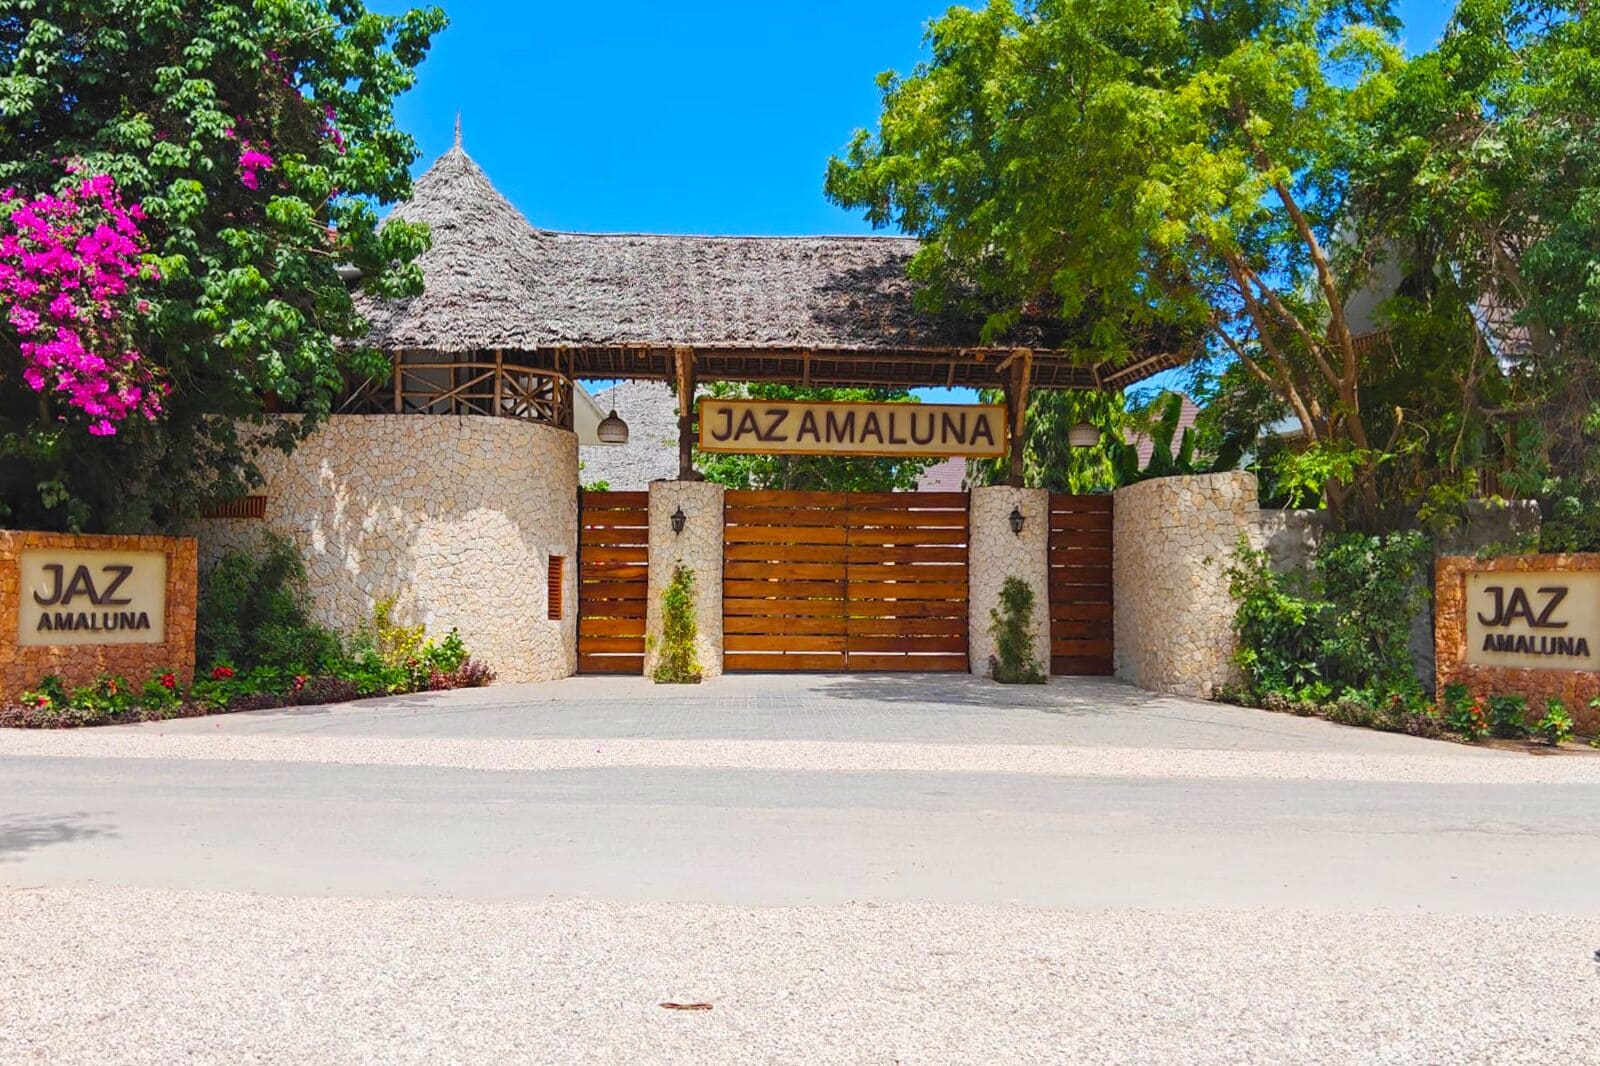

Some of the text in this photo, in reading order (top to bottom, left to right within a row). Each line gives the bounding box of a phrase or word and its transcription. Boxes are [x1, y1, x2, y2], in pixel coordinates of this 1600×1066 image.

[711, 408, 995, 446] JAZ AMALUNA
[33, 564, 134, 606] JAZ
[37, 612, 150, 631] AMALUNA
[1477, 587, 1568, 628] JAZ
[1482, 634, 1590, 657] AMALUNA
